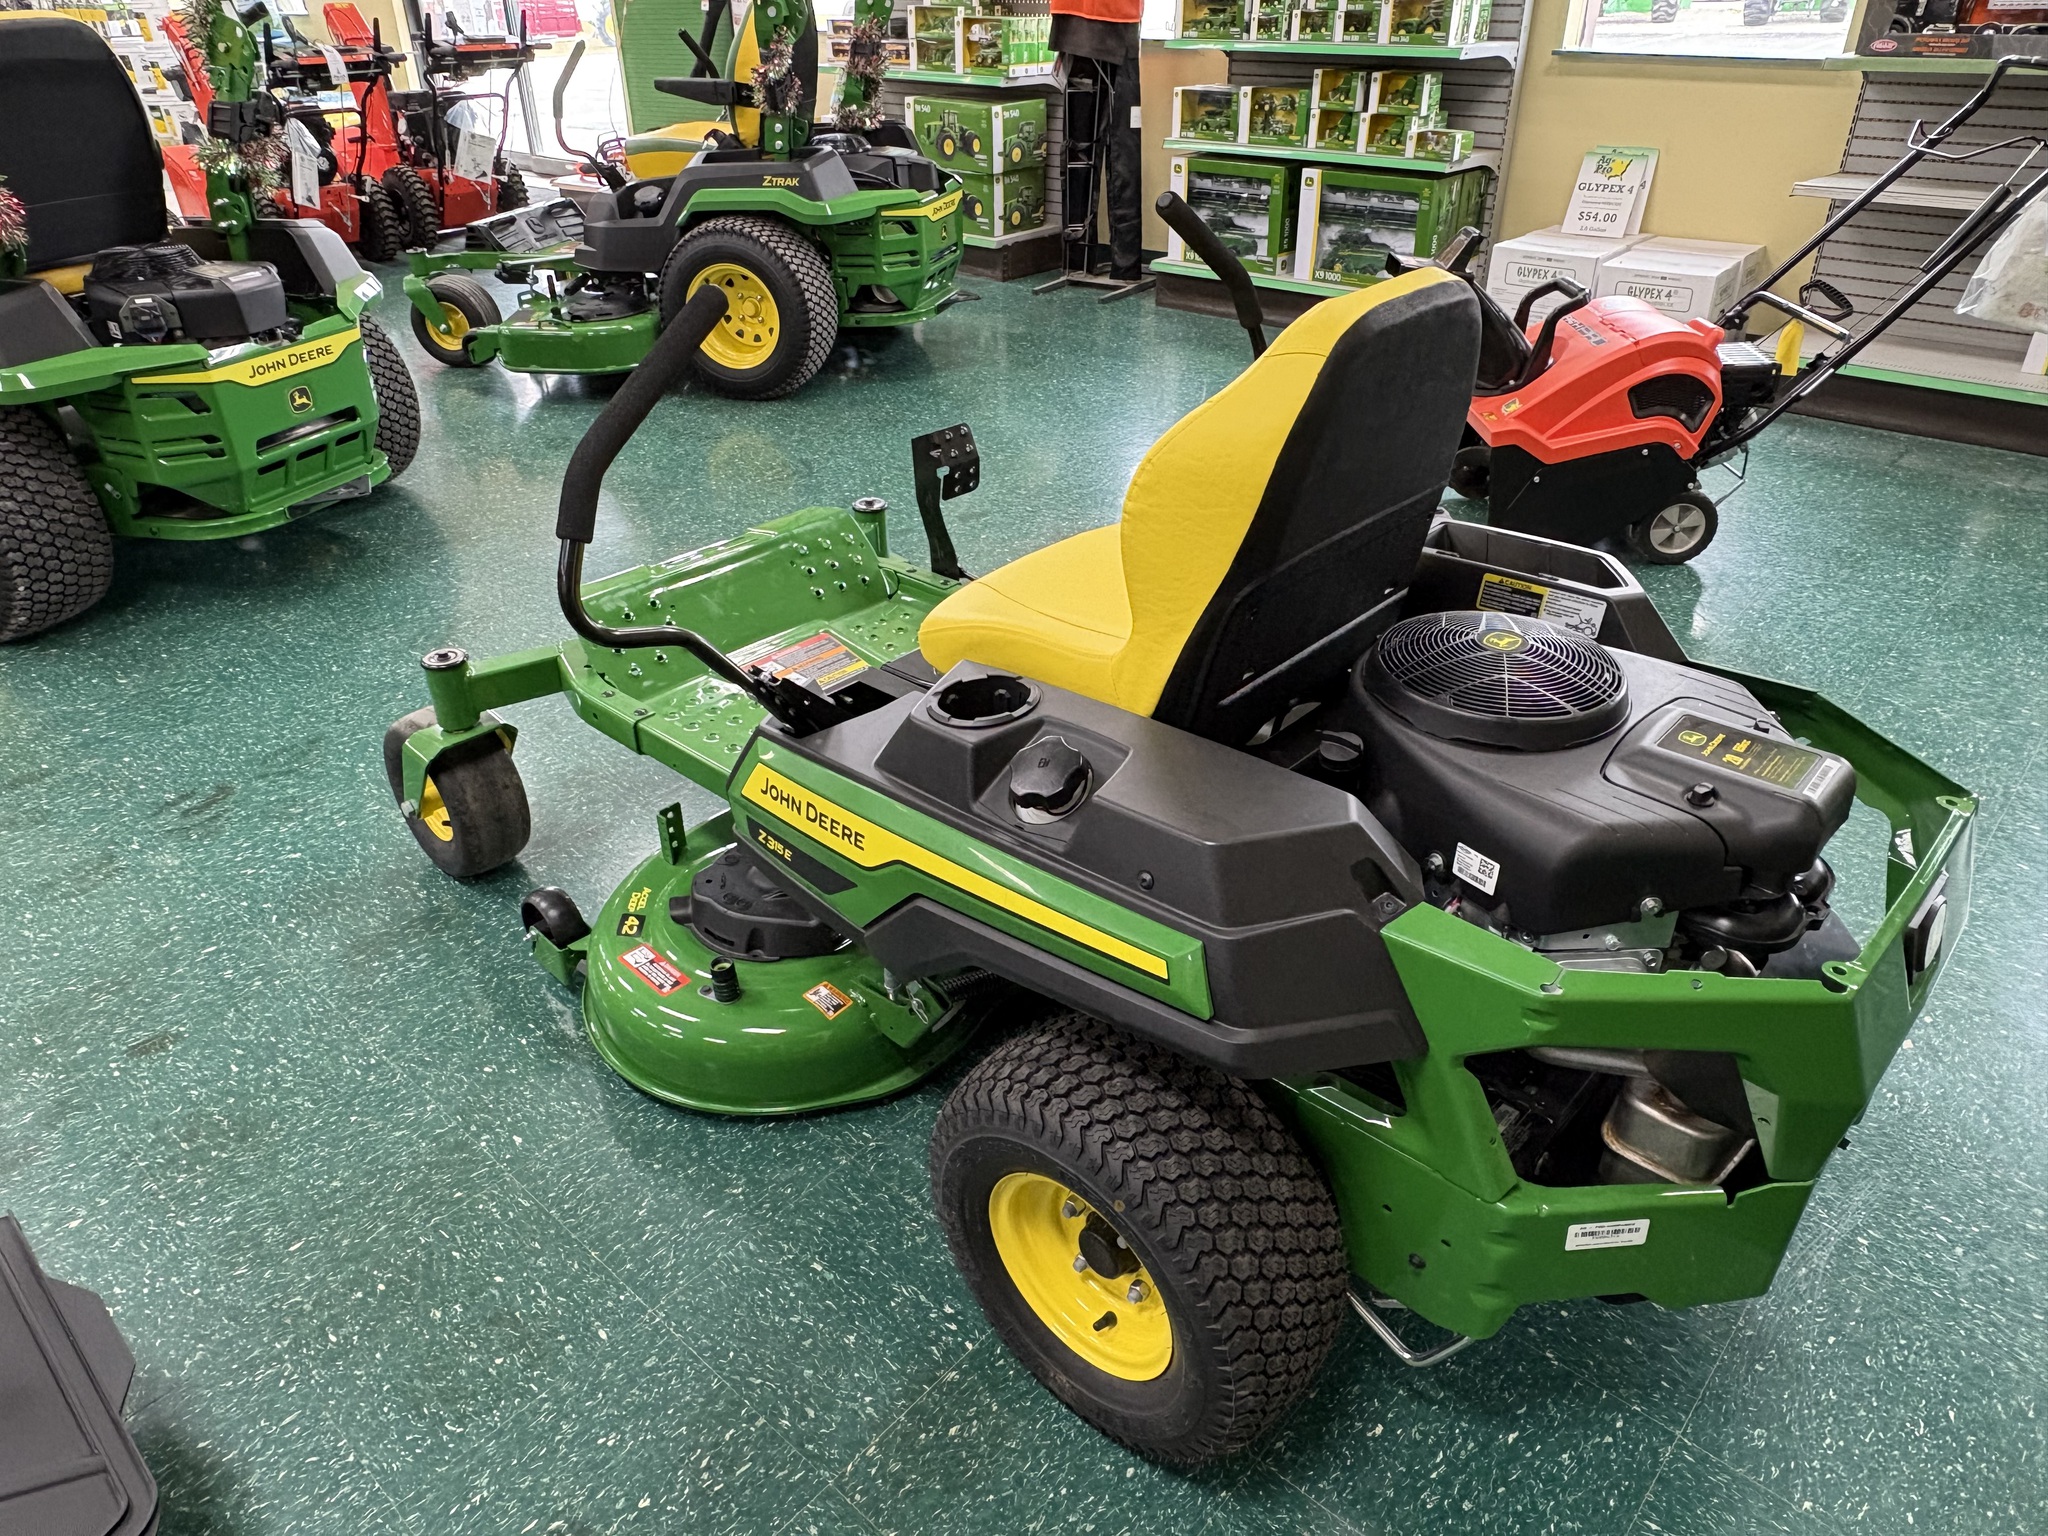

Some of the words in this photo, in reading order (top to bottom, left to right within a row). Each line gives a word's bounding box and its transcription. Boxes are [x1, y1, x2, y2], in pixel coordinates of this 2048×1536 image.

[762, 175, 800, 187] ZTRAK
[1578, 182, 1626, 194] GLYPEX
[1627, 185, 1635, 194] 4
[1578, 211, 1617, 223] $54.00
[1314, 270, 1325, 279] X9
[1325, 271, 1341, 281] 1000
[1517, 266, 1550, 280] GLYPEX
[1627, 285, 1663, 300] GLYPEX
[248, 358, 286, 379] JOHN
[288, 345, 334, 366] DEERE
[1504, 579, 1532, 591] CAUTION
[760, 777, 802, 816] JOHN
[806, 801, 866, 852] DEERE
[627, 892, 642, 913] DEEP
[621, 916, 640, 935] 42
